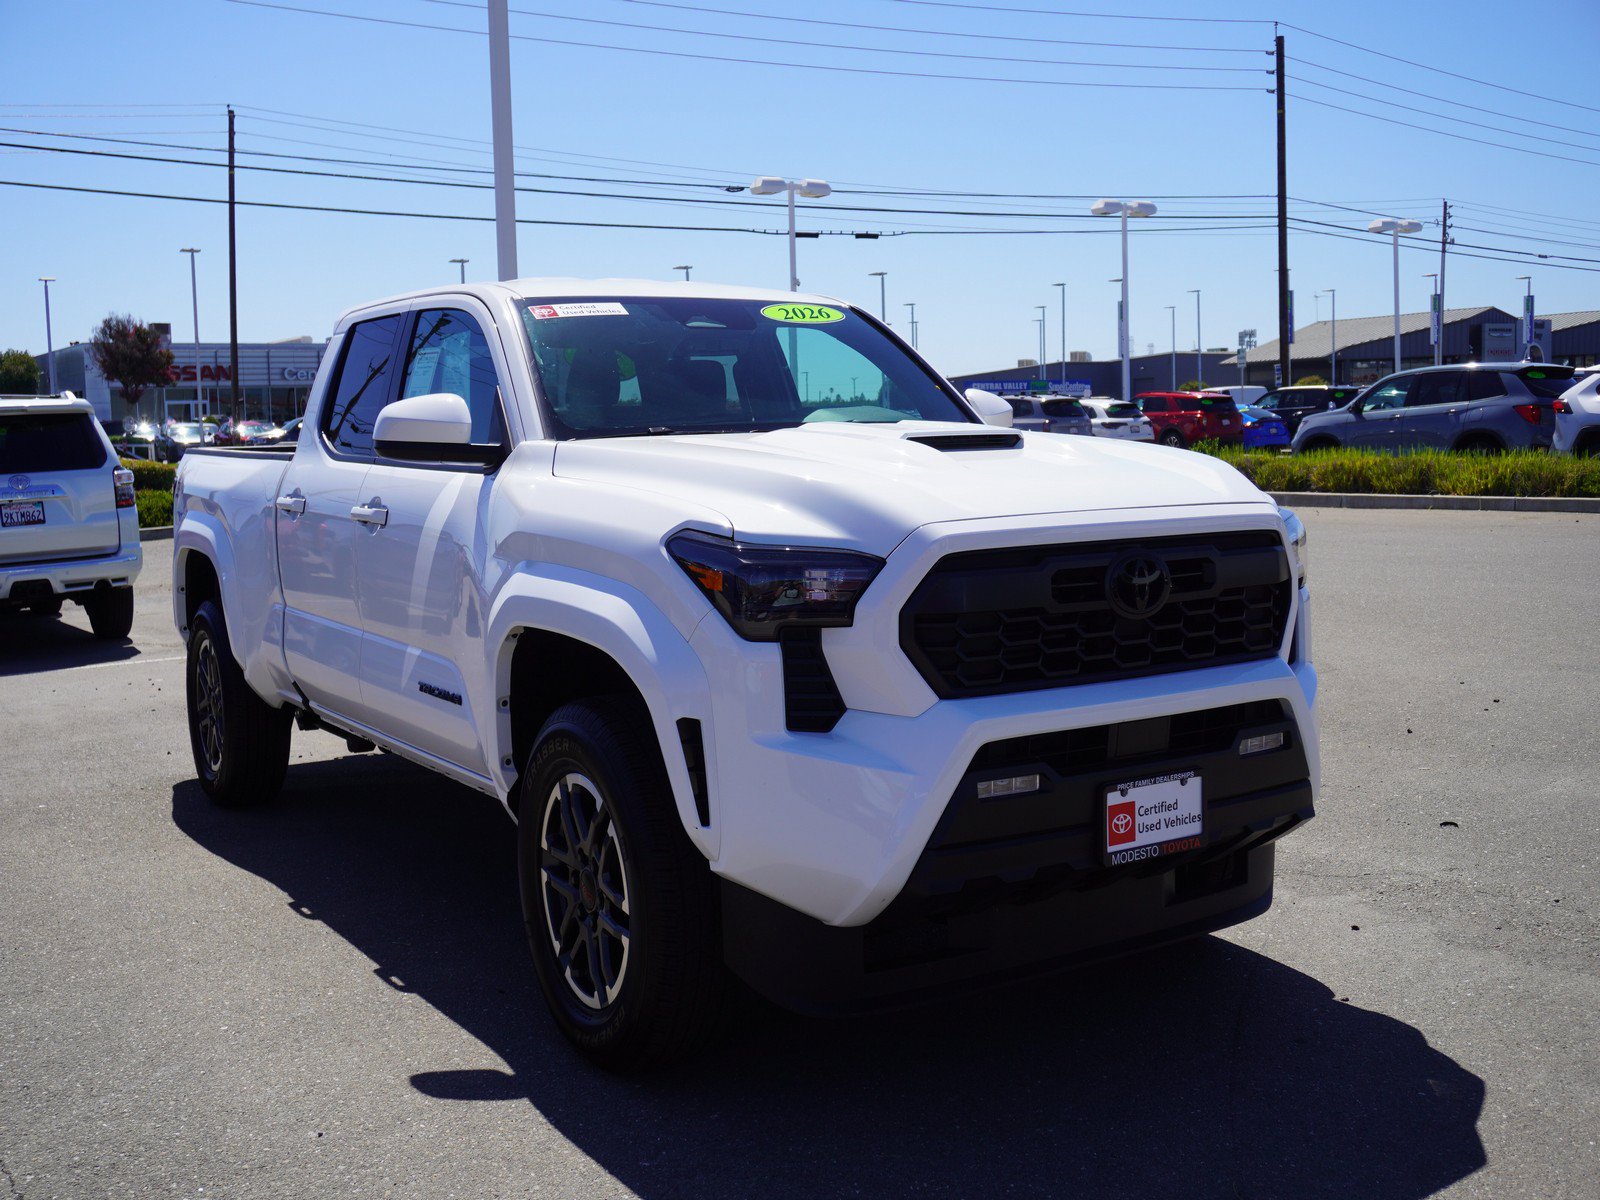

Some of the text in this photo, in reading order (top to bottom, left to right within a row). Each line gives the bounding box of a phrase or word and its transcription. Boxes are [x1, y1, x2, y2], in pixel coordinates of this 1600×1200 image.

[778, 307, 831, 320] 2026
[972, 382, 1003, 390] CENTRAL
[1003, 382, 1028, 390] VALLEY
[4, 509, 41, 523] 9KTM862
[1117, 771, 1195, 791] PRICE FAMILY DEALERSHIPS
[1137, 798, 1178, 817] Certified
[1138, 812, 1202, 834] Used Vehicles
[1111, 837, 1201, 866] MODESTO TOYOTA
